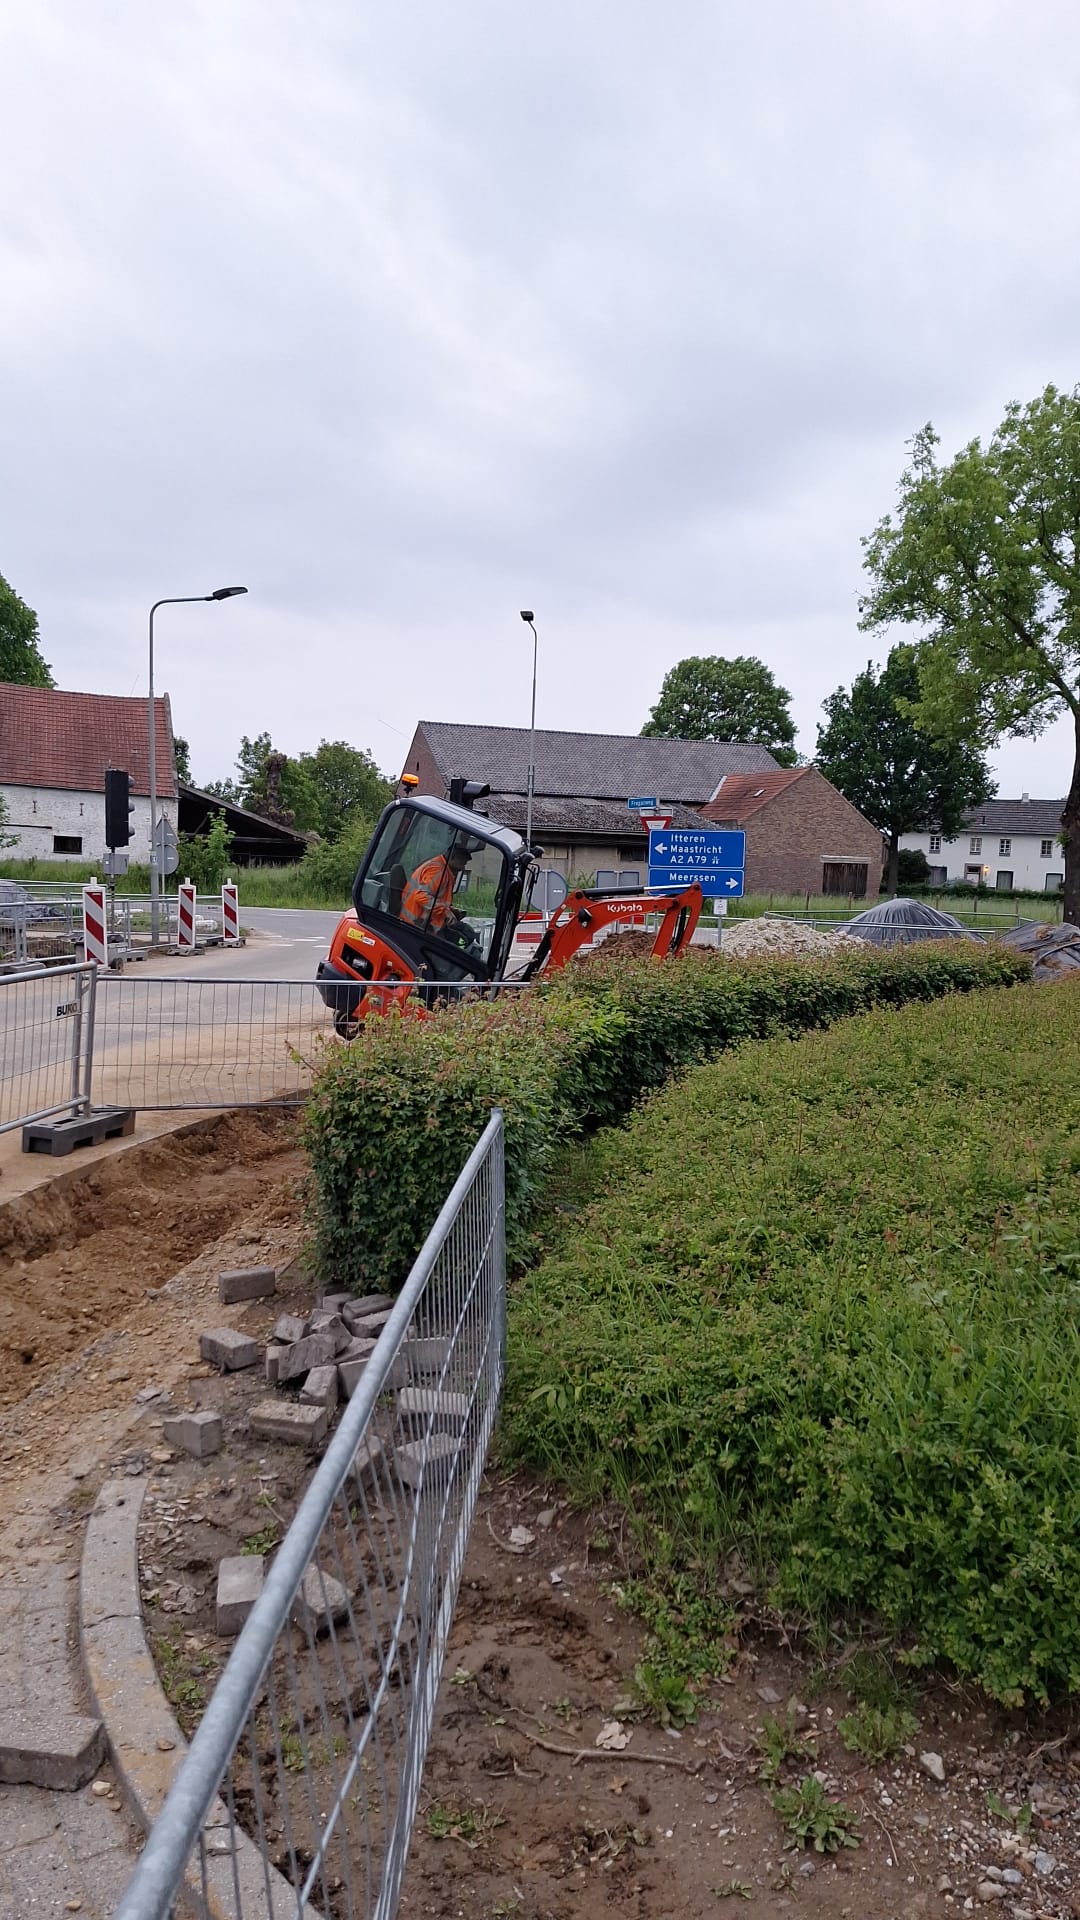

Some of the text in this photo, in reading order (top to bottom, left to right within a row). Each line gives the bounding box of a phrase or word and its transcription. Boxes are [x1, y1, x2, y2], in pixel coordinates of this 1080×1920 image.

[671, 834, 705, 843] Itteren
[670, 844, 722, 854] Maastricht
[670, 855, 707, 864] A2 A79
[669, 873, 716, 882] Meerssen
[607, 903, 643, 912] Kubota
